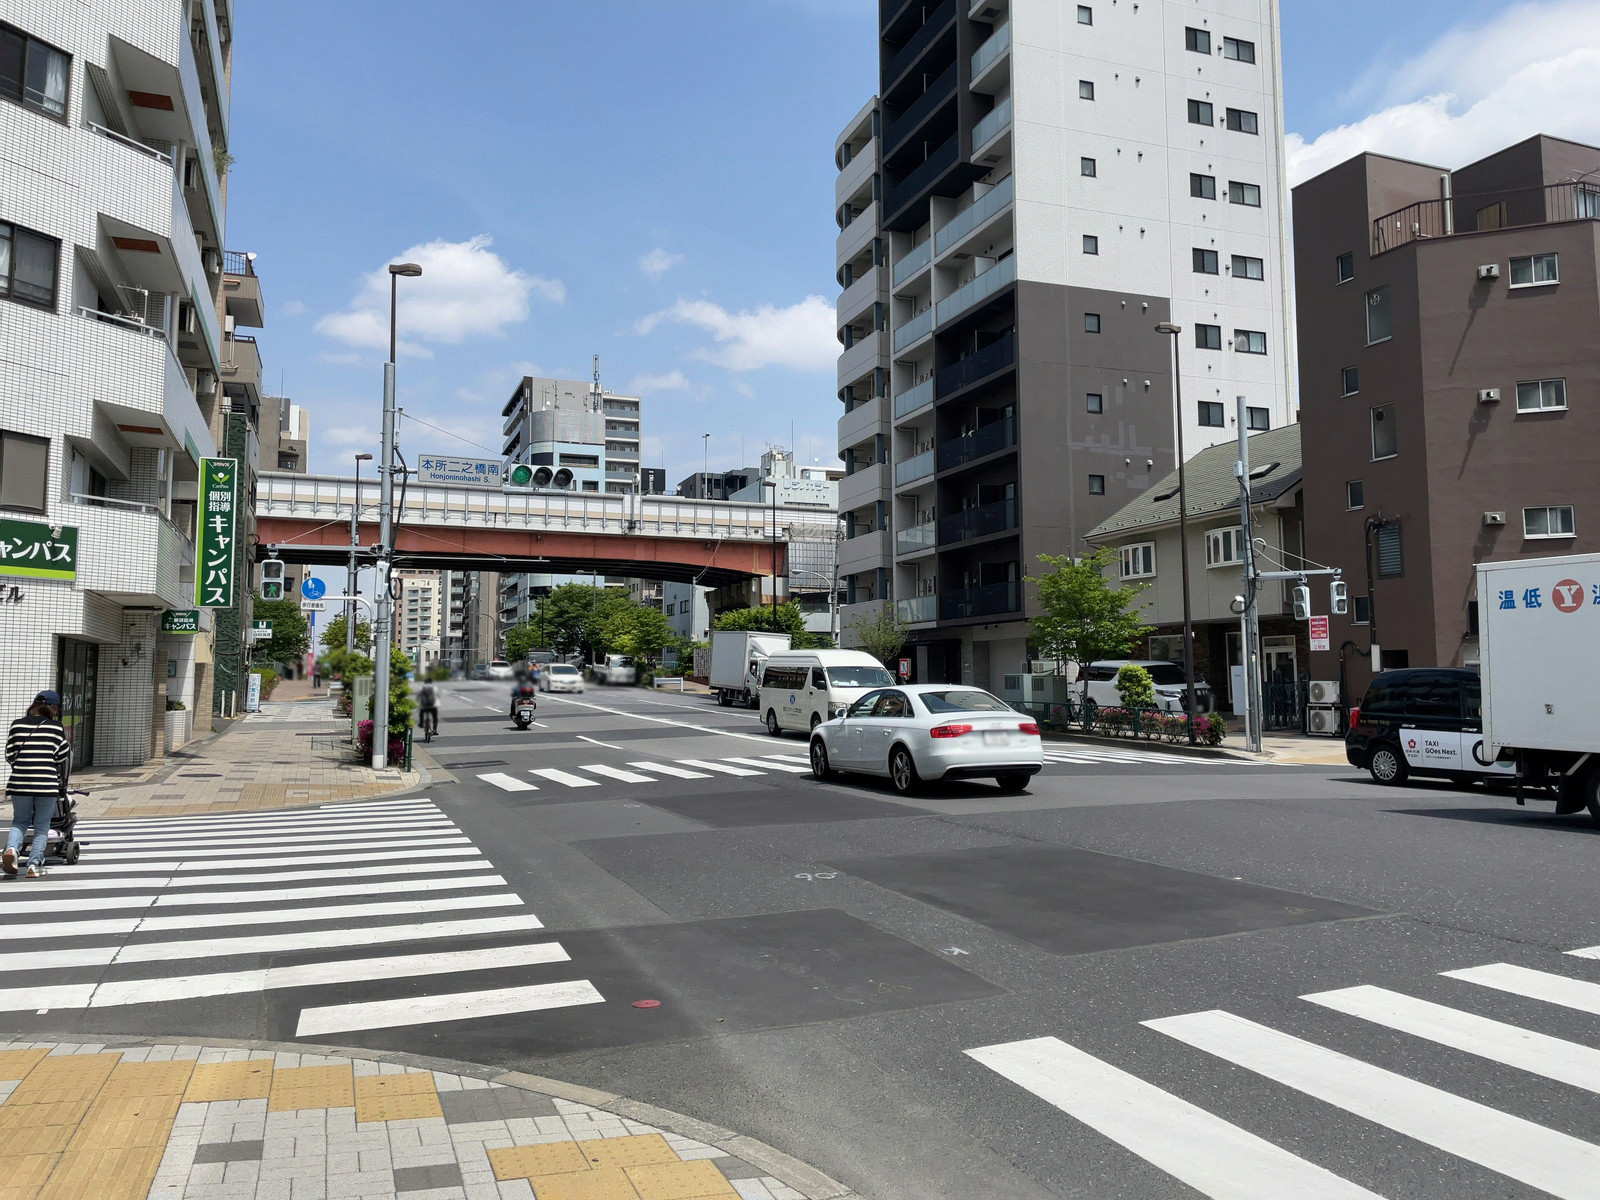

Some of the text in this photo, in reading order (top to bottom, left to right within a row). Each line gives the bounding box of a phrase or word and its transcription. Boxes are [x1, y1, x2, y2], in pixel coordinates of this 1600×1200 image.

[422, 459, 499, 476] 本所二之橋南
[430, 472, 491, 484] Honjoninohashi S.
[209, 491, 231, 501] 個別
[209, 502, 231, 512] 指導
[205, 515, 230, 604] キャンパス
[164, 622, 197, 630] キャンパス
